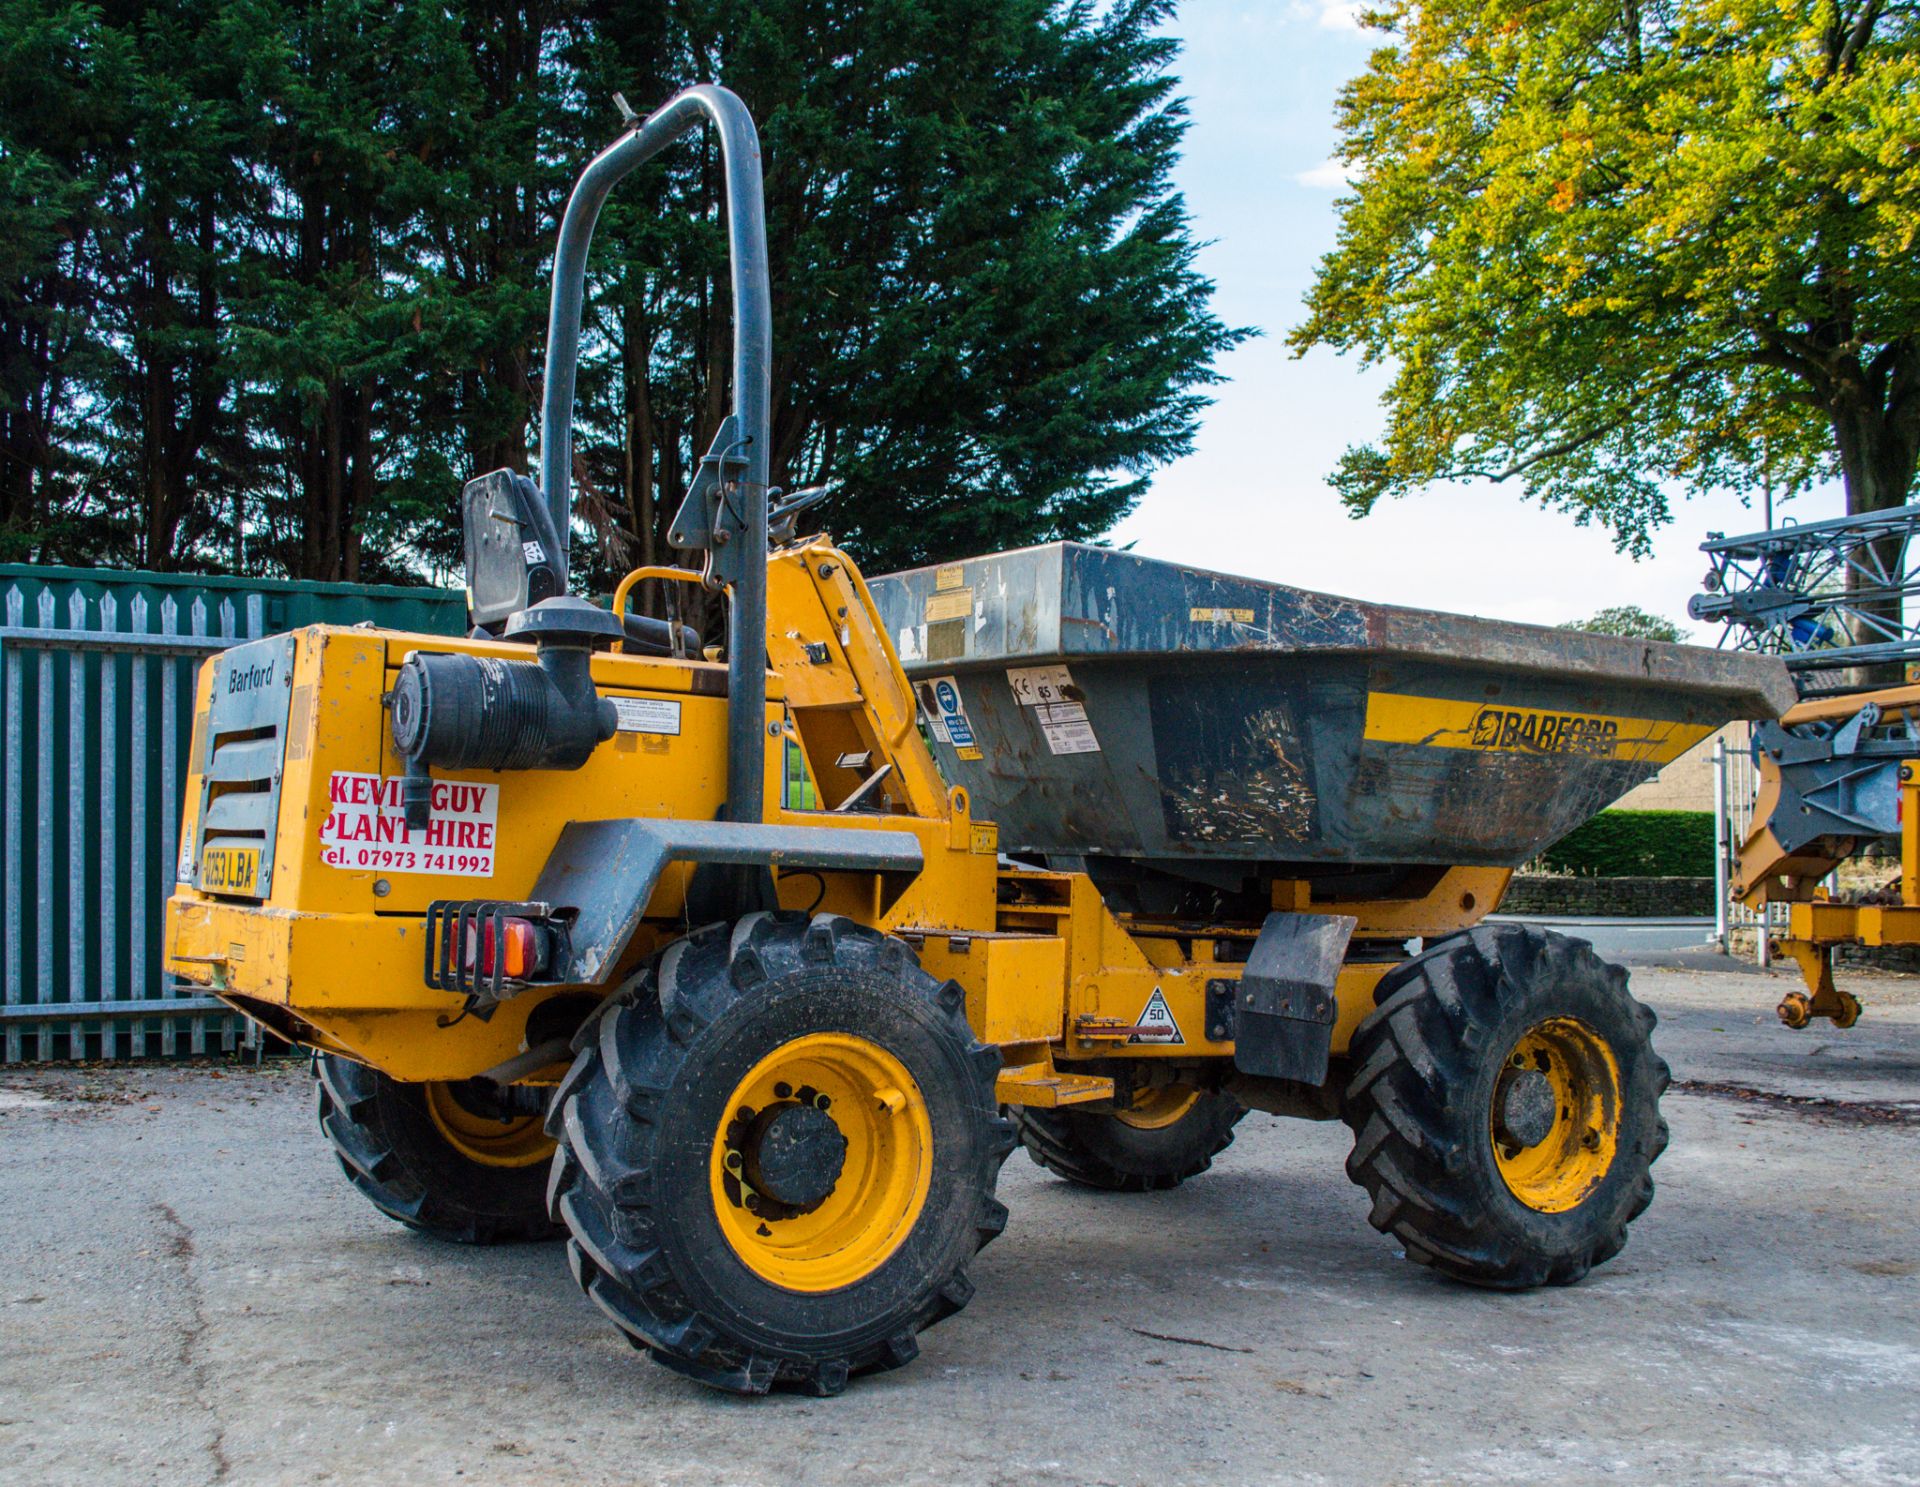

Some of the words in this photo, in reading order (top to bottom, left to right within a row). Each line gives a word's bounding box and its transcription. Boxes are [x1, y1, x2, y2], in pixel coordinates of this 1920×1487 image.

[228, 660, 275, 694] Barford
[1037, 686, 1051, 698] 85
[330, 775, 405, 808] KEVI
[431, 783, 487, 814] GUY
[318, 812, 411, 845] PLANT
[424, 819, 493, 850] HIRE
[228, 852, 252, 889] LBA
[357, 848, 416, 869] 07973
[423, 853, 490, 873] 741992
[1149, 1008, 1165, 1021] 50
